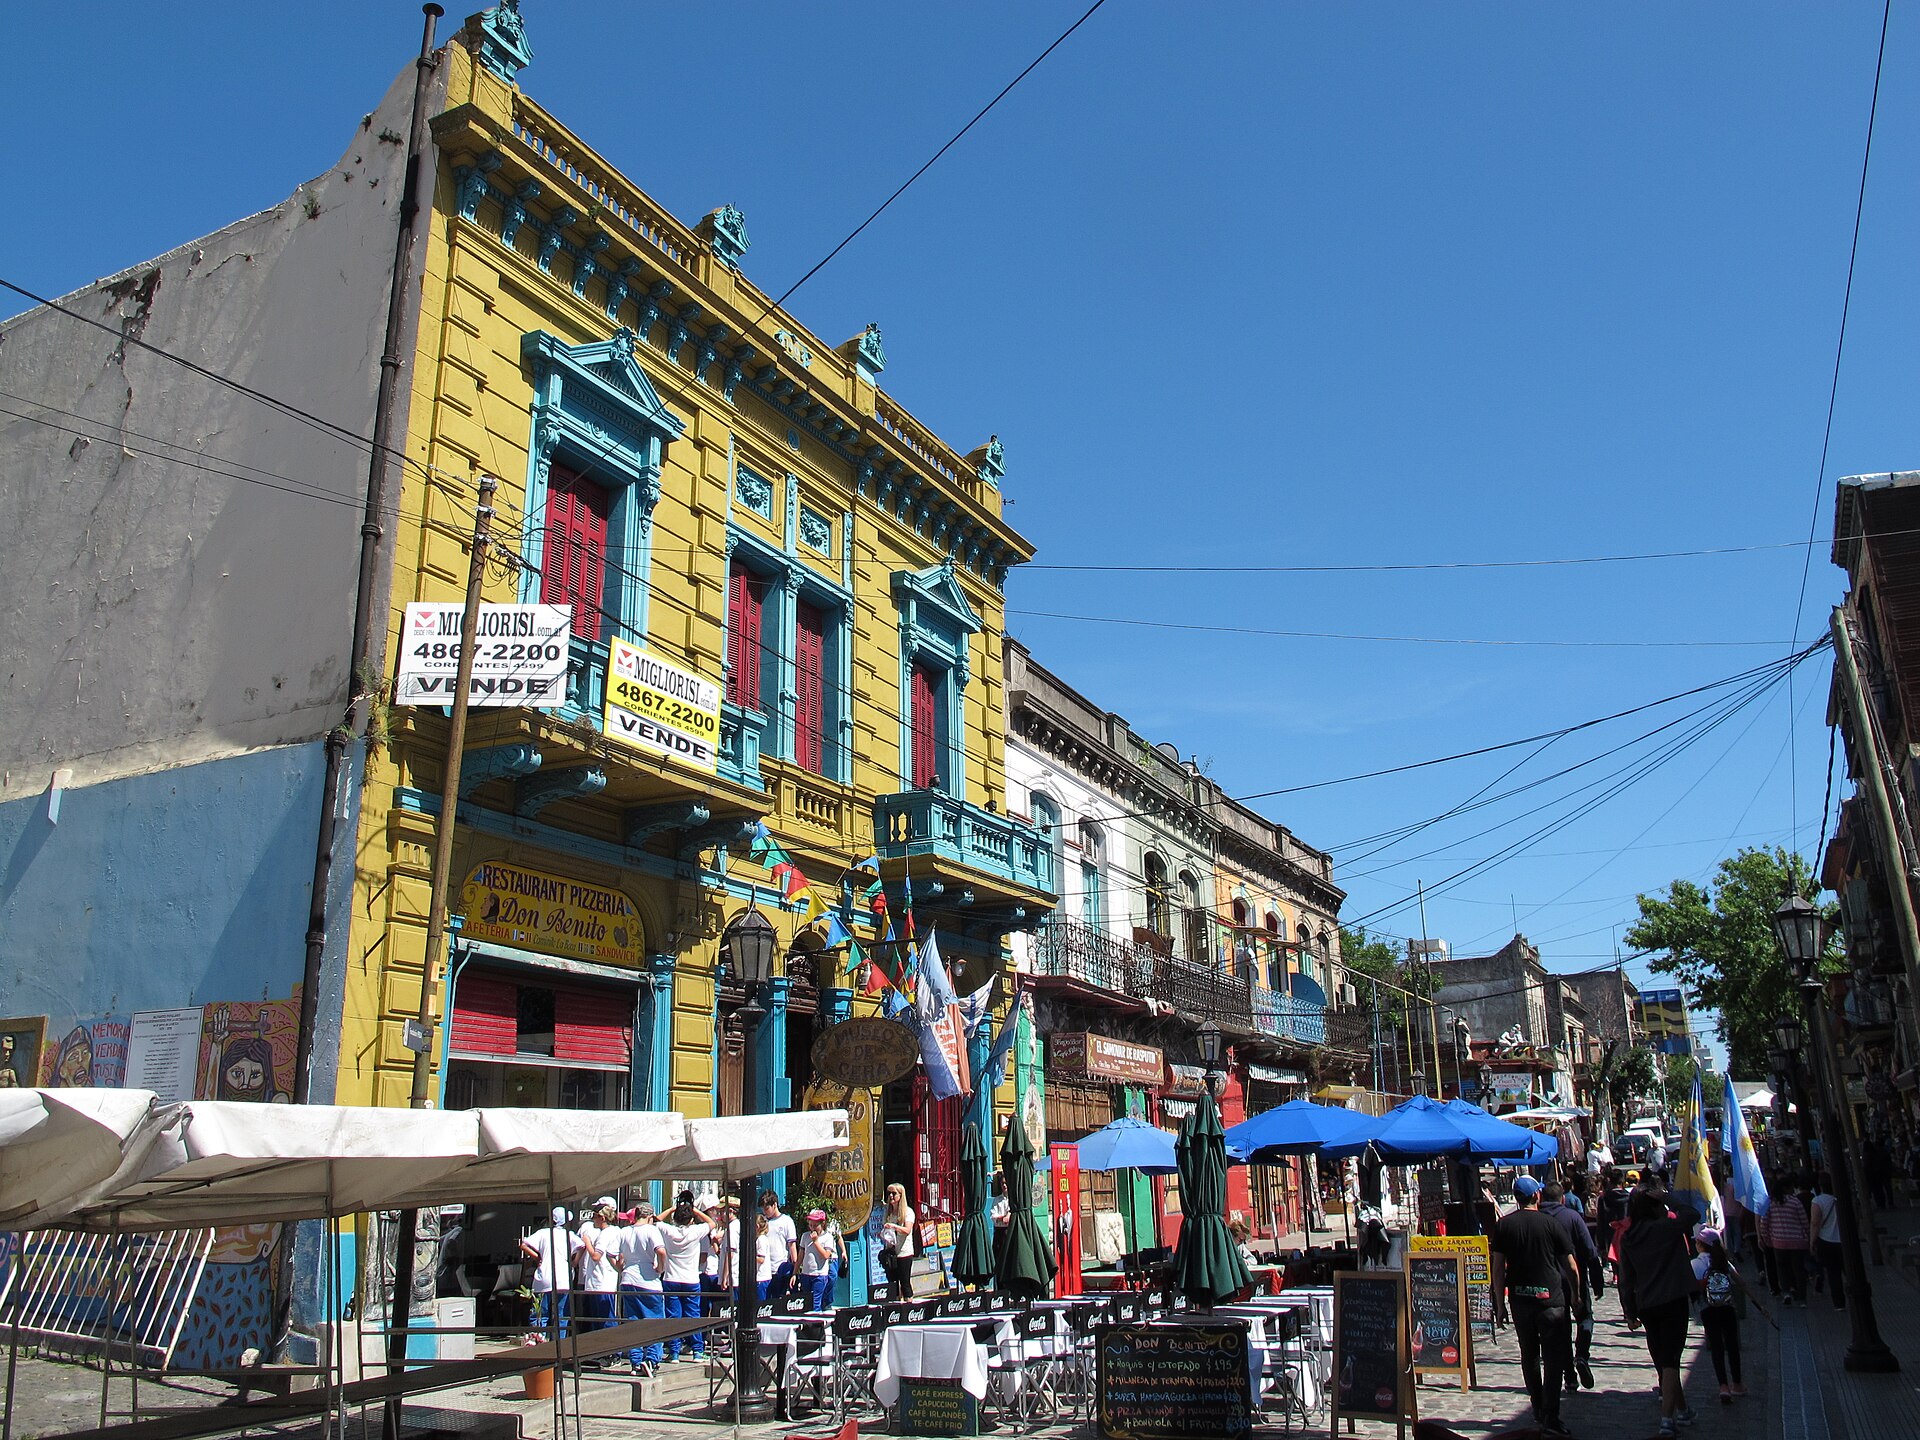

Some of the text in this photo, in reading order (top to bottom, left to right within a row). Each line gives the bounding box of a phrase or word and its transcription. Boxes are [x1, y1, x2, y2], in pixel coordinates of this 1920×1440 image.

[416, 677, 548, 694] VENDE
[616, 682, 714, 732] 4867-2200
[624, 701, 704, 737] CORRIENTES 4599
[620, 714, 706, 760] VENDE
[482, 864, 626, 916] RESTAURANT PIZZERIA
[498, 898, 608, 942] Don Benito
[596, 946, 635, 960] SANDWICH
[92, 1022, 130, 1042] MEMORIA
[835, 1024, 894, 1042] MUSEO
[855, 1045, 875, 1060] DE
[1096, 1040, 1102, 1054] EL
[1126, 1046, 1132, 1060] DE
[838, 1062, 890, 1080] CERA
[1061, 1164, 1066, 1175] DE
[1059, 1178, 1069, 1192] CERA
[948, 1300, 966, 1312] Coca-Cola
[848, 1314, 872, 1330] Coca-Cola
[1028, 1316, 1046, 1332] Coca-Cola
[1116, 1376, 1150, 1385] MILANESA
[1162, 1376, 1195, 1386] TERNERA
[912, 1388, 964, 1399] CAFÉ EXPRESS
[1114, 1392, 1136, 1402] SUPER
[918, 1400, 958, 1408] CAPUCCINO
[908, 1408, 966, 1420] CAFÉ IRLANDÉS
[1118, 1406, 1142, 1418] PIZZA
[945, 1422, 962, 1430] FRIO
